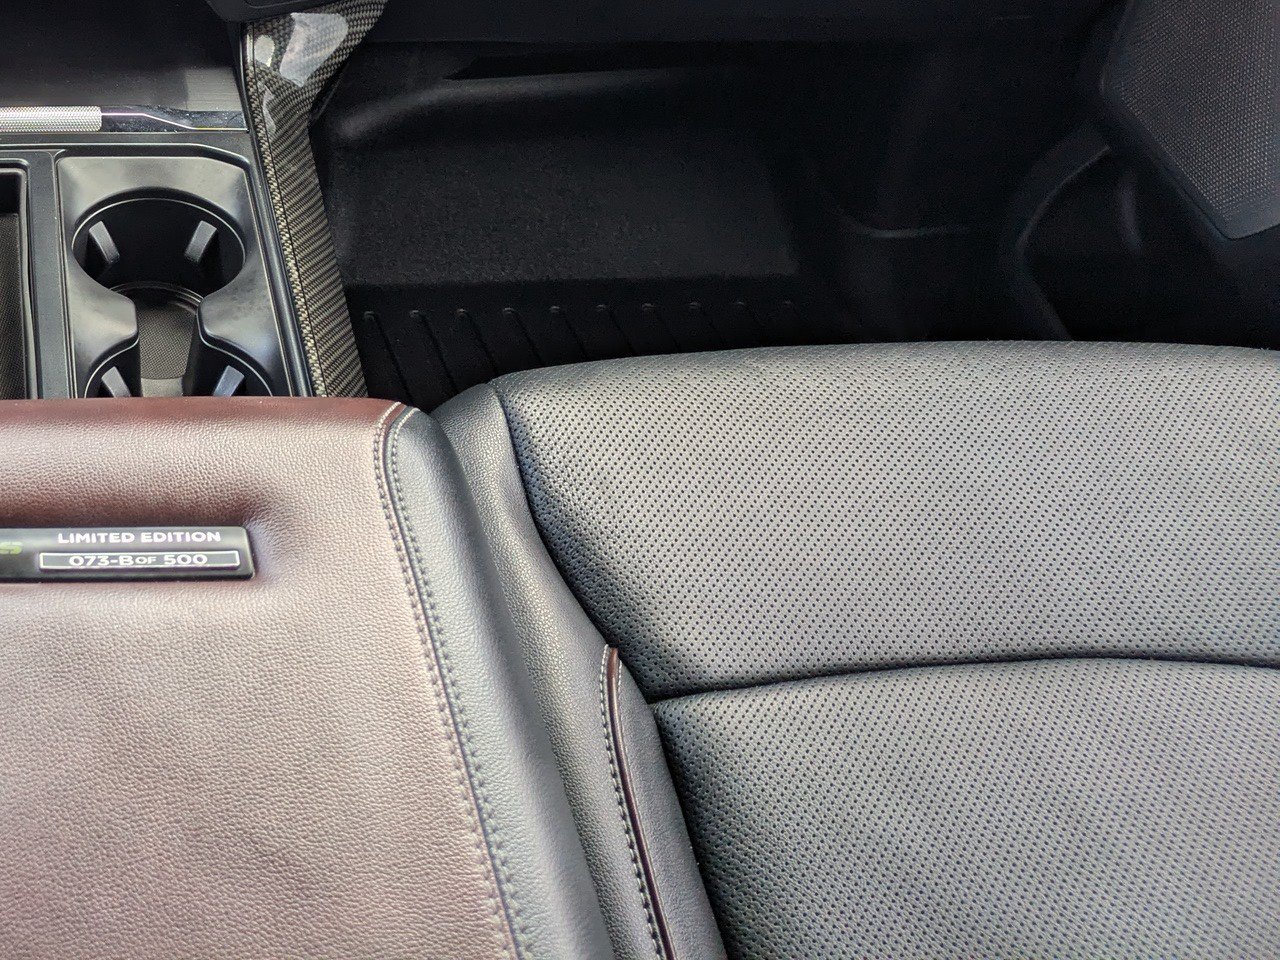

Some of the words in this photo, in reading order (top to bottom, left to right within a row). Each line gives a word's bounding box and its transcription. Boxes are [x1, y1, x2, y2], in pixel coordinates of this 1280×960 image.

[58, 532, 135, 544] LIMITED
[140, 531, 221, 543] EDITION
[164, 554, 208, 566] 500
